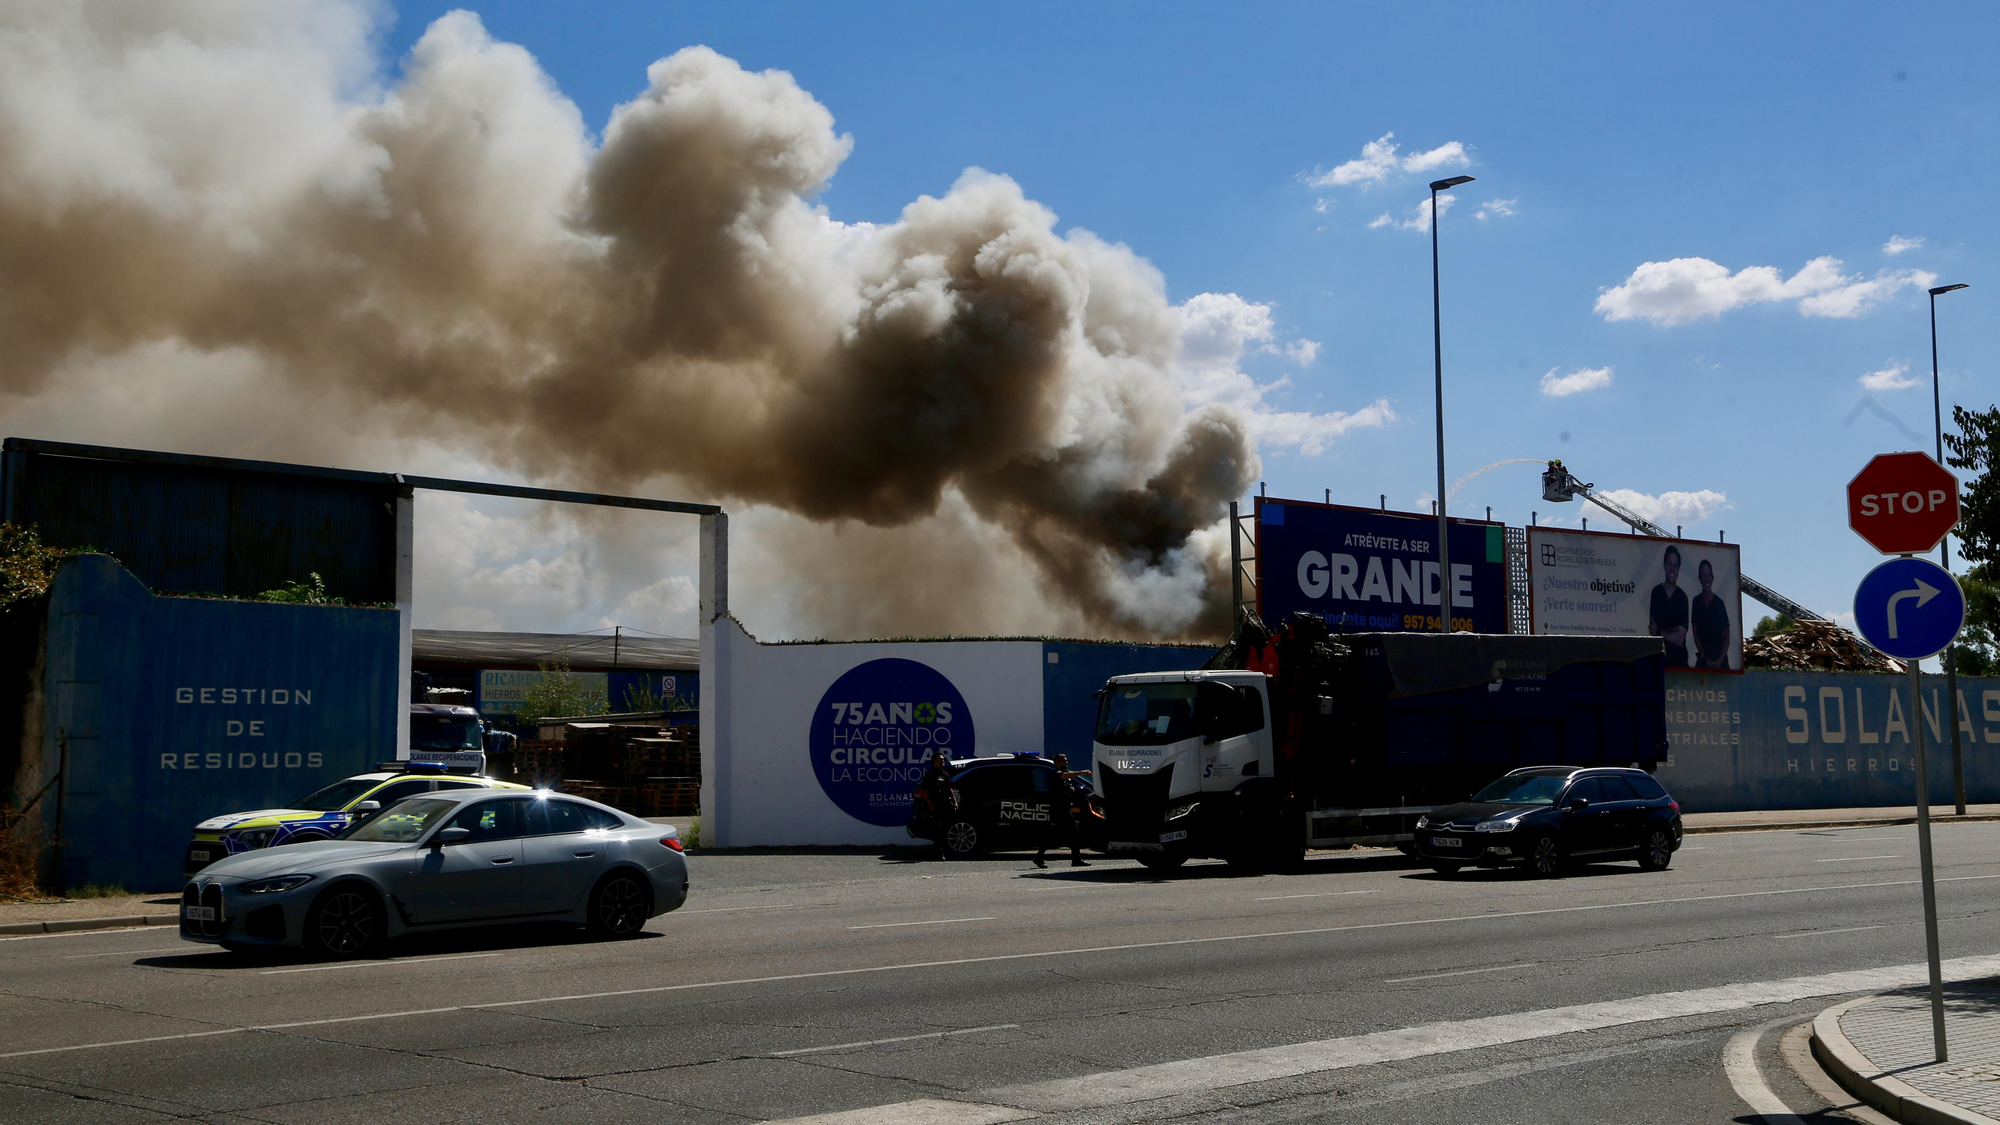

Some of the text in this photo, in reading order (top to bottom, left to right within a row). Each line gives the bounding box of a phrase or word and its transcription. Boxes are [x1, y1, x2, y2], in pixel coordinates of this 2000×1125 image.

[1860, 490, 1946, 516] STOP
[1344, 532, 1430, 553] ATRÉVETE A SER
[1297, 550, 1474, 608] GRANDE
[1543, 576, 1635, 595] ¿Nuestro objetivo?
[1544, 596, 1574, 612] ¡Verte
[1369, 613, 1399, 630] aquí!
[1404, 614, 1425, 630] 957
[1451, 617, 1474, 632] 006
[1507, 660, 1547, 670] SOLANAS
[485, 672, 544, 687] RICARDO
[175, 687, 312, 705] GESTION
[485, 689, 520, 700] HIERROS
[1666, 689, 1726, 702] CHIVOS
[1665, 711, 1741, 724] NEDORES
[226, 720, 265, 737] DE
[833, 727, 951, 745] HACIENDO
[160, 752, 323, 770] RESIDUOS
[410, 753, 479, 762] OLANAS RECUPERACIONES
[830, 747, 953, 764] CIRCULAR
[831, 766, 928, 782] LA ECONO
[1000, 801, 1051, 812] POLIC
[1000, 810, 1051, 822] NACIO
